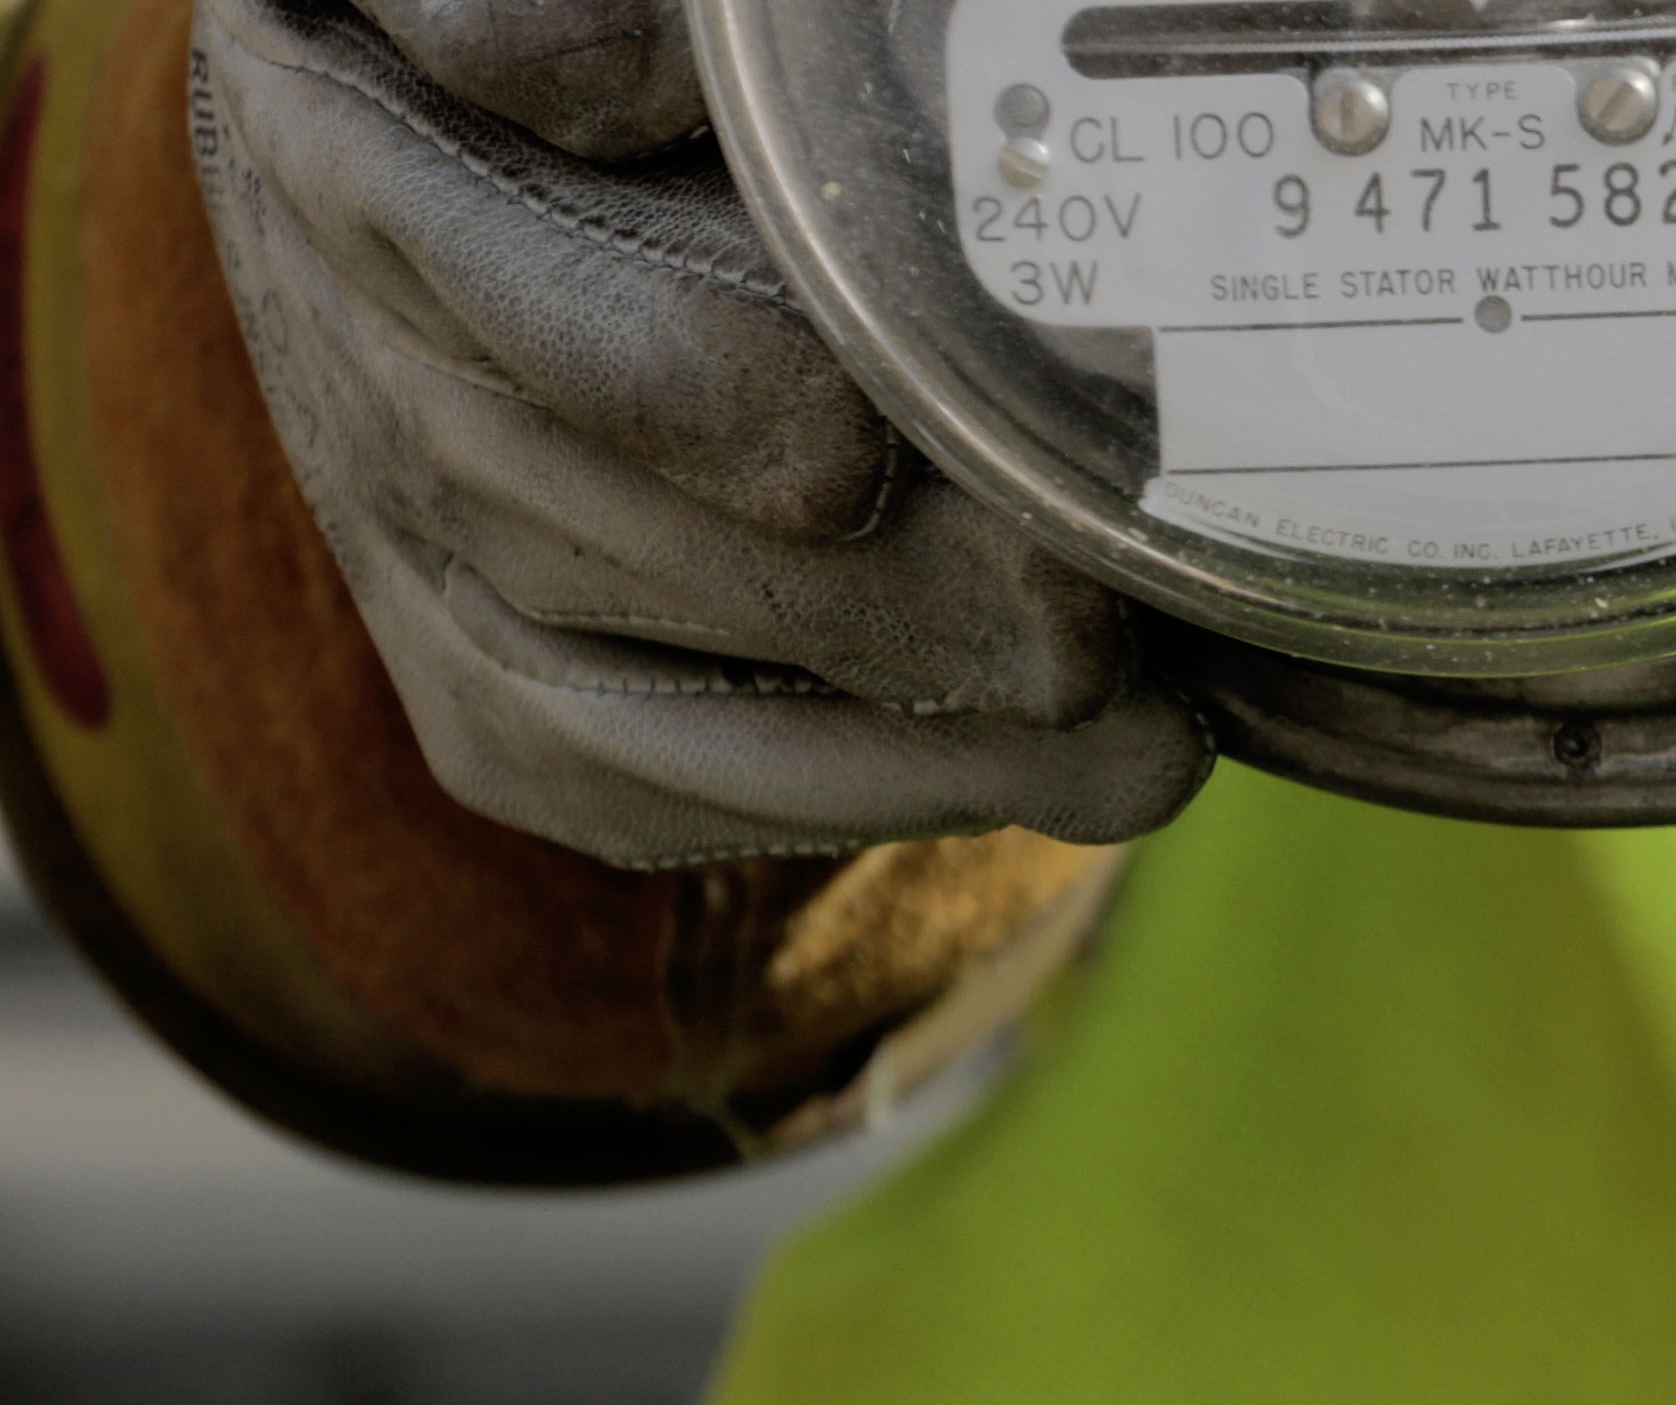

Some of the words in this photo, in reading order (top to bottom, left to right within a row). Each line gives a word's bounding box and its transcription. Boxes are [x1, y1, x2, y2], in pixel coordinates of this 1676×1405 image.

[1446, 81, 1518, 101] TYPE
[1070, 116, 1145, 164] CL
[1173, 111, 1274, 161] 100
[1419, 113, 1546, 153] MK-S
[972, 192, 1142, 244] 240V
[1273, 174, 1310, 238] 9
[1354, 167, 1503, 231] 471
[1010, 259, 1099, 306] 3W
[1210, 271, 1323, 302] SINGLE
[1340, 267, 1456, 297] STATOR
[1476, 264, 1648, 294] WATTHOUR
[1165, 480, 1259, 529] DUNCAN
[1275, 518, 1391, 556] ELECTRIC
